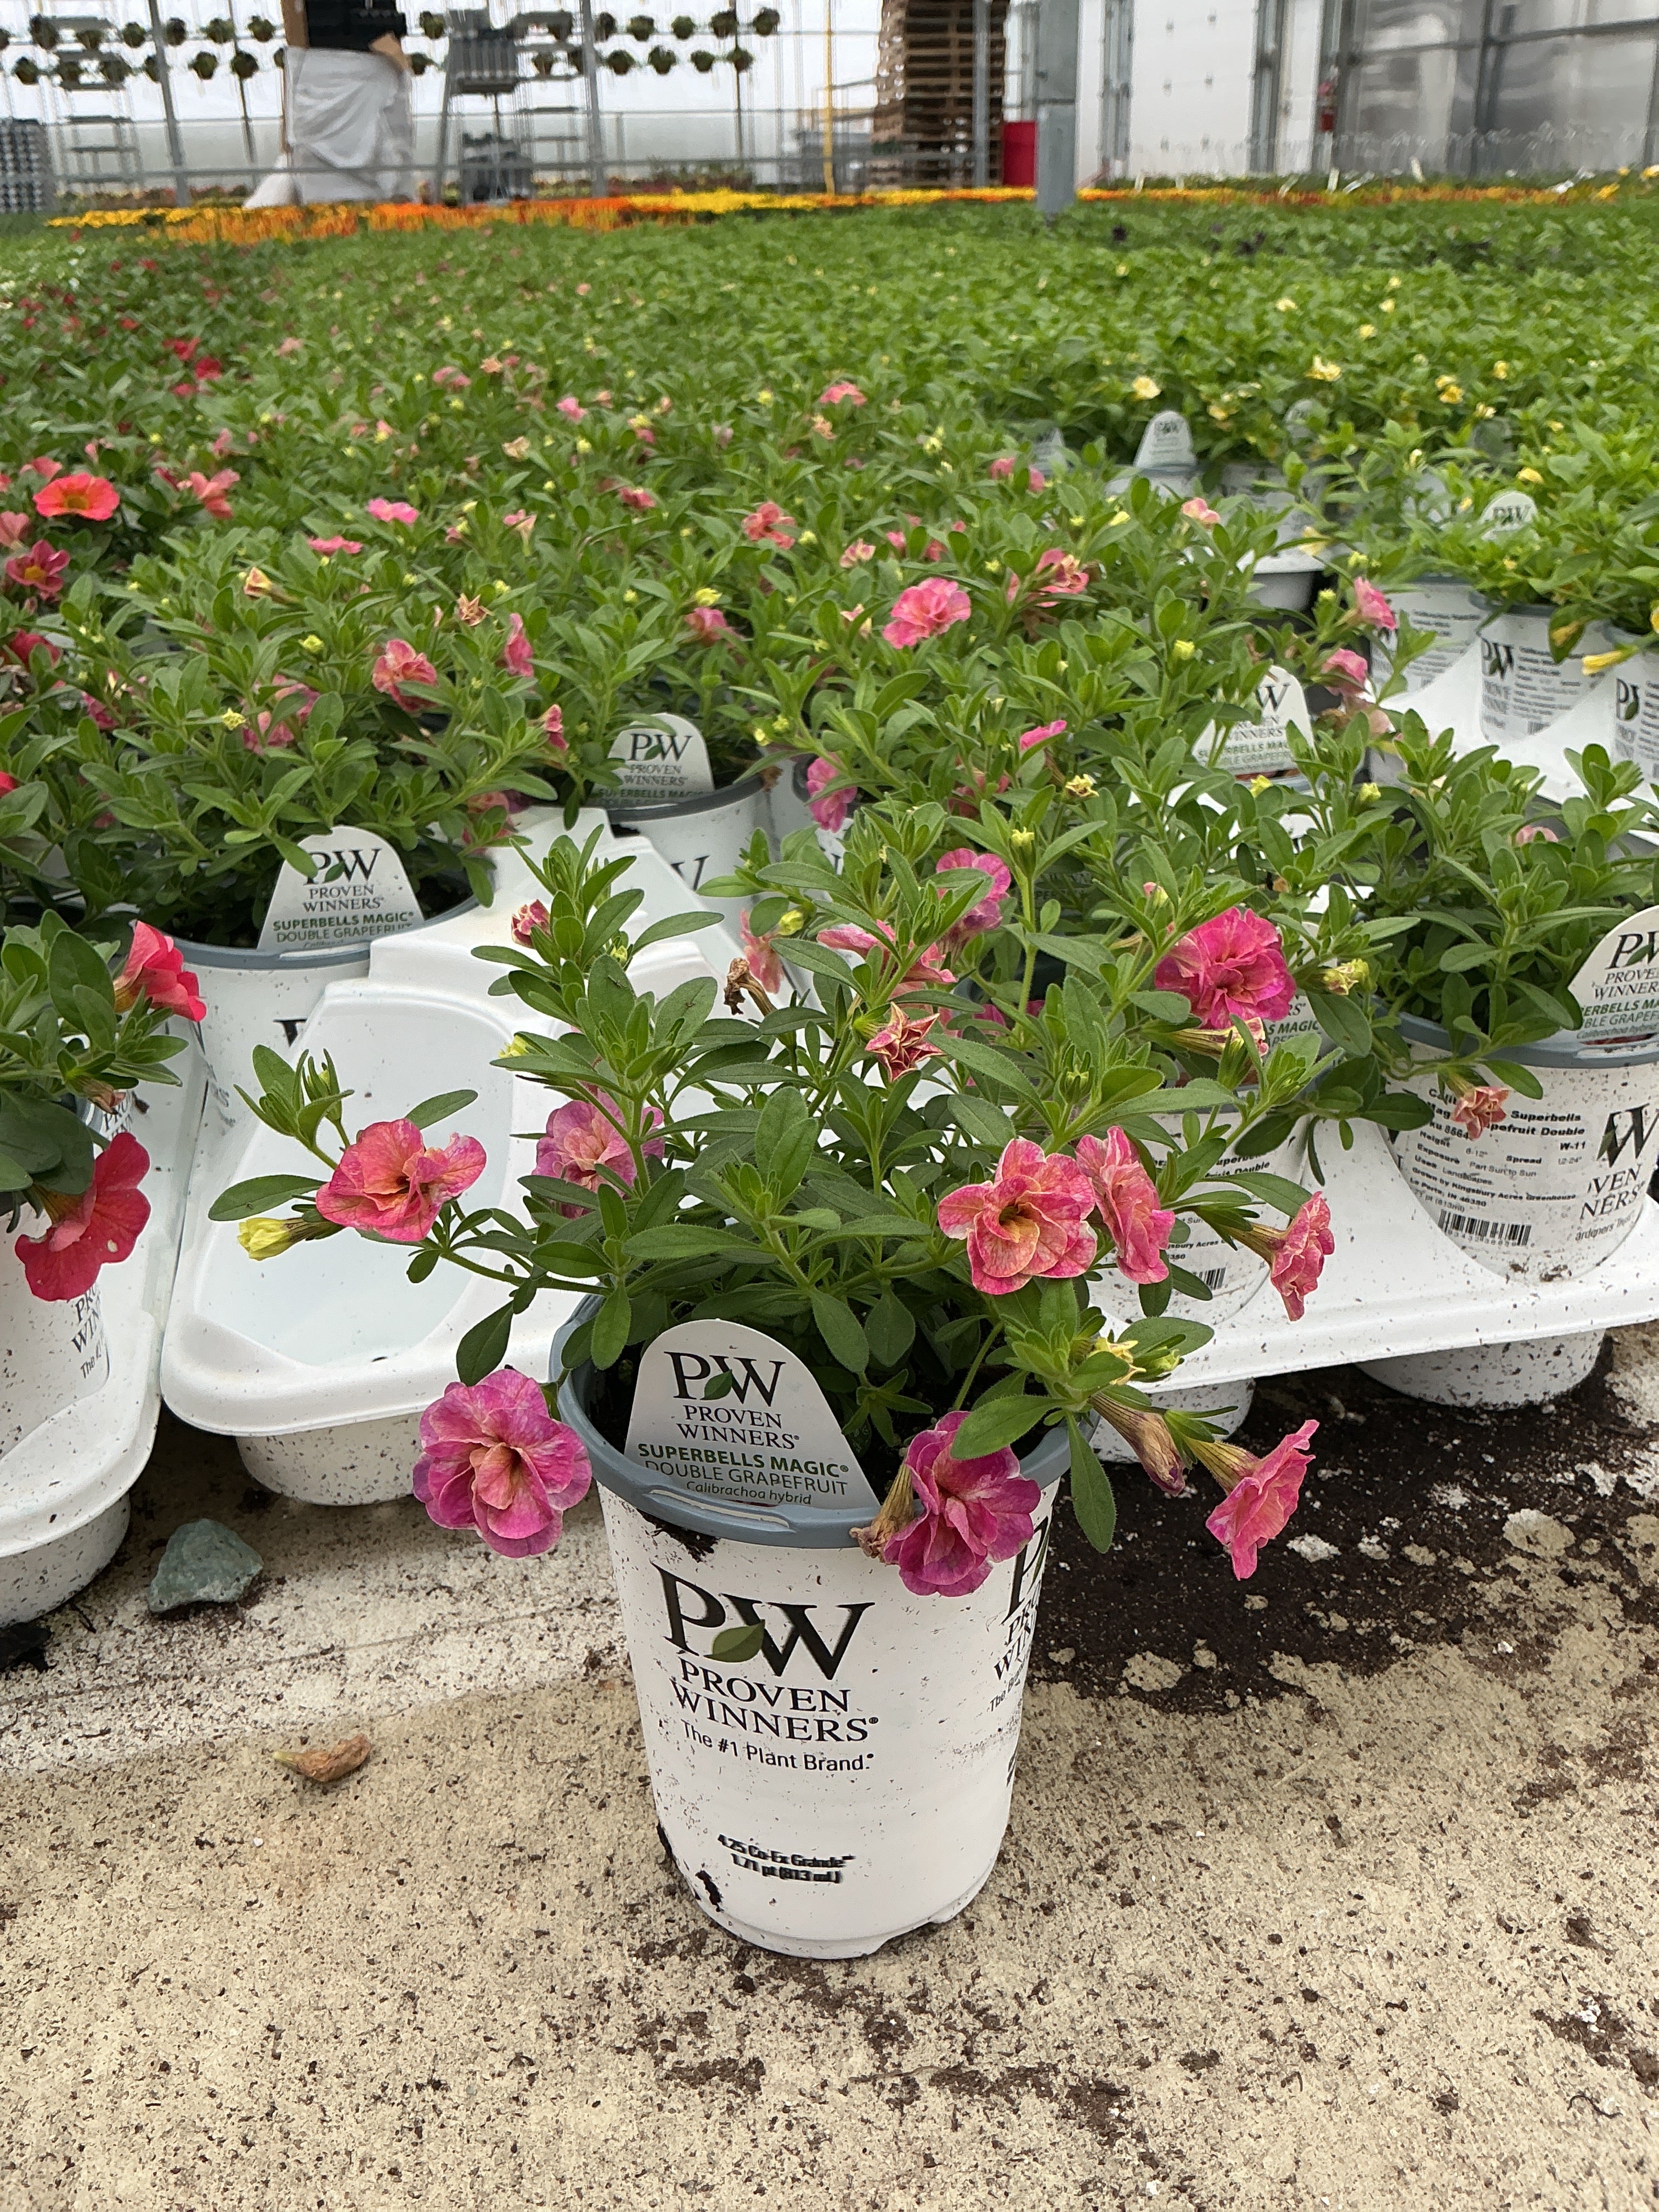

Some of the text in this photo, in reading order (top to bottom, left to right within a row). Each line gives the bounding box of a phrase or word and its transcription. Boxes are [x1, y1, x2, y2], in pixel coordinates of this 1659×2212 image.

[630, 733, 693, 762] PW
[629, 764, 682, 775] PROVEN
[309, 884, 374, 899] PROVEN
[273, 915, 360, 932] SUPERBELLS
[276, 927, 330, 943] DOUBLE
[1605, 967, 1659, 985] PROVE
[1594, 980, 1659, 1001] WINNER
[1510, 1110, 1582, 1123] Superbells
[1541, 1127, 1585, 1137] Double
[1417, 1142, 1460, 1165] Exposure
[1506, 1154, 1542, 1165] Spread
[1452, 1182, 1496, 1199] Kingsbury
[1498, 1192, 1523, 1200] Acres
[663, 1351, 786, 1407] PW
[682, 1404, 782, 1429] PROVEN
[637, 1442, 765, 1469] SUPERBELLS
[644, 1460, 848, 1496] DOUBLE GRAPEFRUIT
[686, 1481, 812, 1505] Calibrachoa hybrid
[648, 1559, 876, 1681] PW
[677, 1656, 851, 1713] PROVEN
[681, 1719, 713, 1748] The
[717, 1738, 738, 1757] #1
[746, 1743, 798, 1770] Plant
